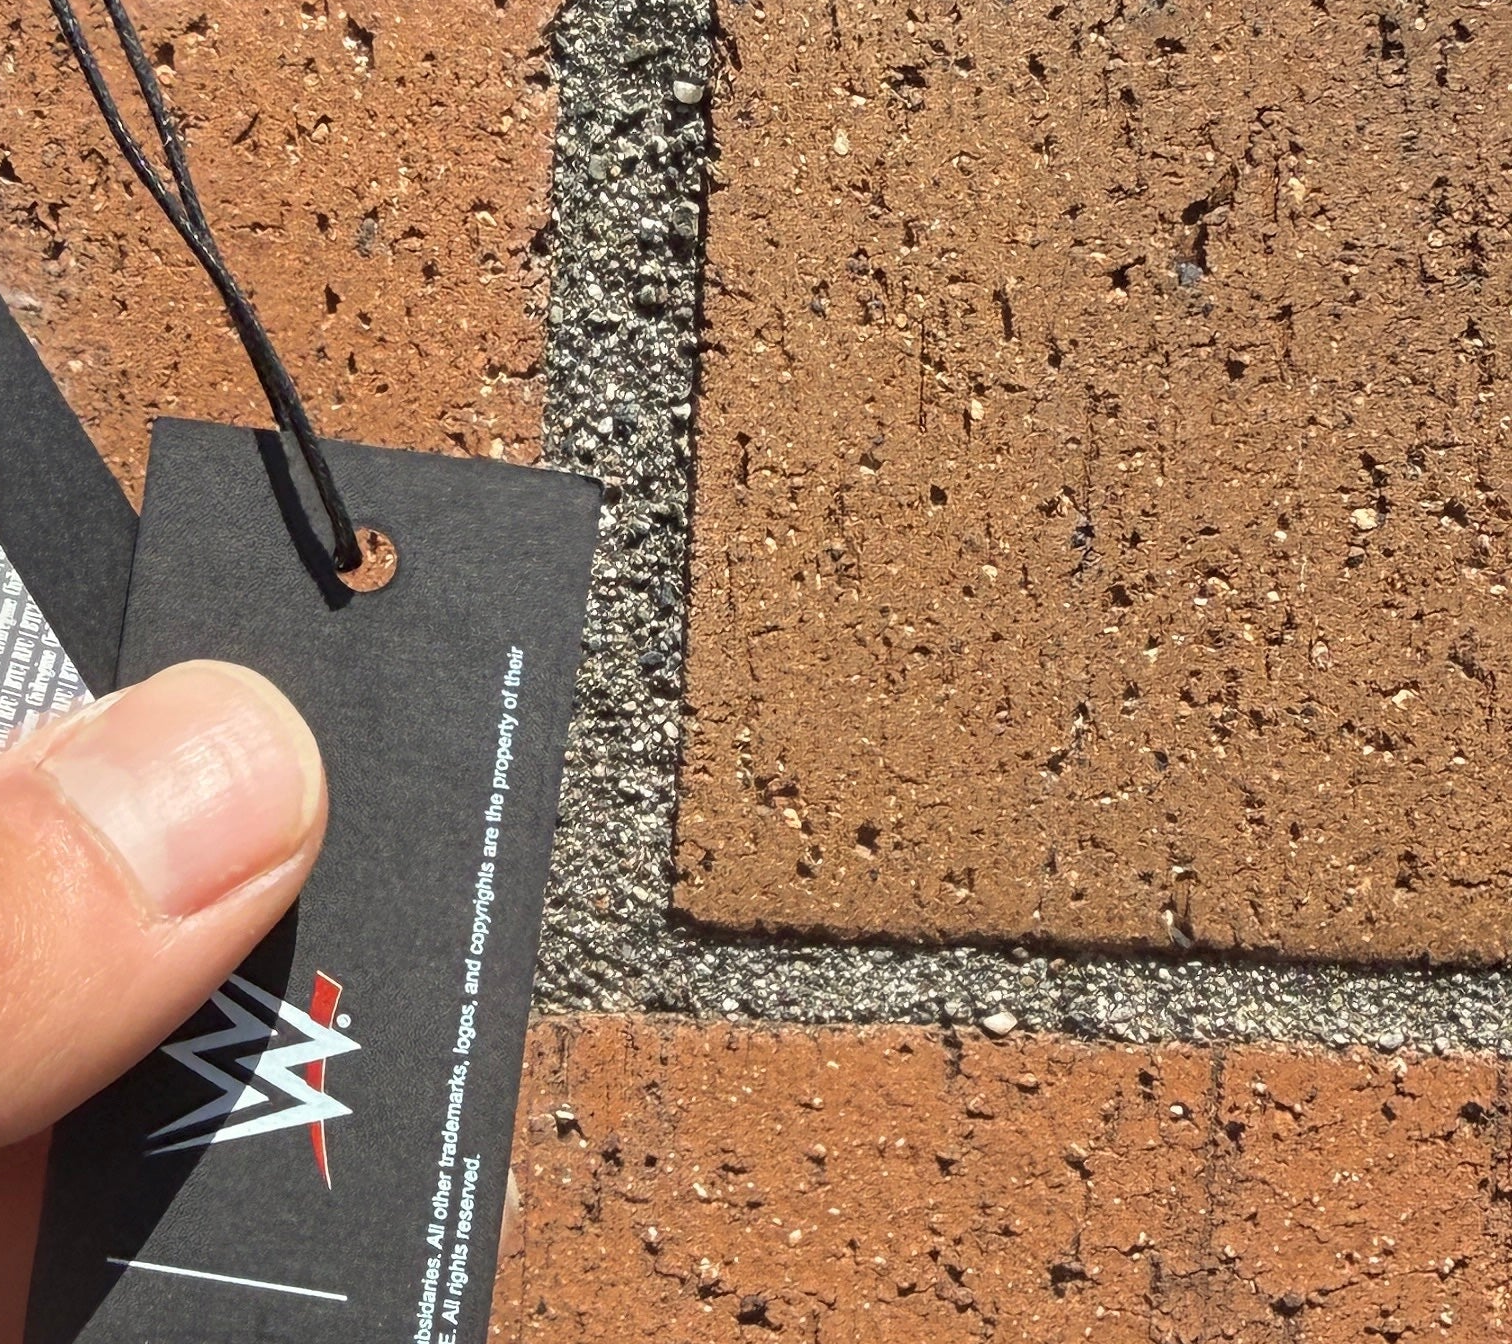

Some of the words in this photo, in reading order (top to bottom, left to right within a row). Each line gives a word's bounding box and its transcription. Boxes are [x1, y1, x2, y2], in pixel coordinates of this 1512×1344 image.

[10, 636, 35, 663] RFC
[503, 645, 524, 687] their
[501, 688, 519, 710] of
[492, 713, 519, 790] property
[483, 793, 505, 822] the
[483, 826, 500, 858] are
[469, 861, 495, 955] copyrights
[464, 958, 482, 995] and
[452, 1000, 479, 1055] logos,
[437, 1060, 471, 1168] trademarks,
[431, 1170, 452, 1221] other
[456, 1153, 481, 1240] reserved.
[426, 1223, 445, 1250] All
[446, 1243, 469, 1296] rights
[441, 1298, 461, 1326] All
